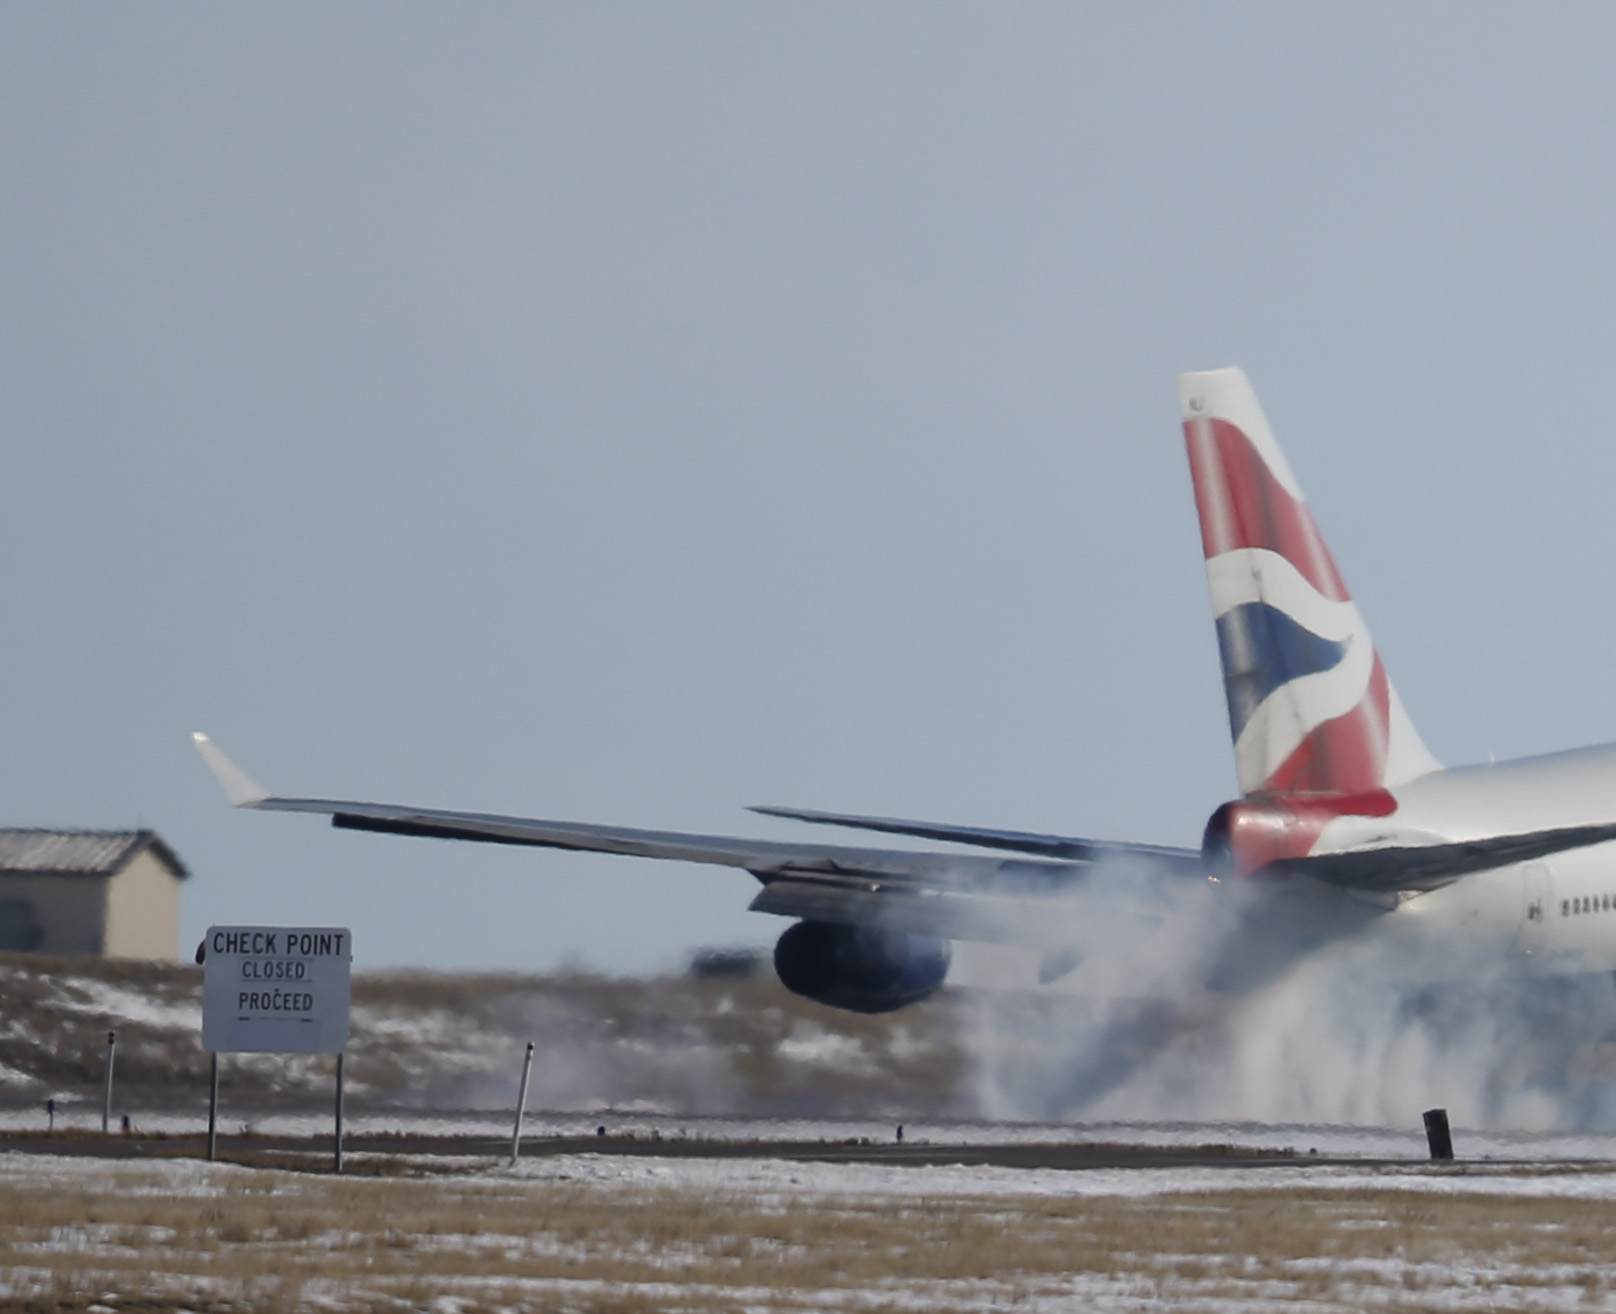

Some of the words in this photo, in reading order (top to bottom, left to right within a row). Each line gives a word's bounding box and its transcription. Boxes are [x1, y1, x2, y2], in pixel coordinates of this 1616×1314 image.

[213, 932, 277, 954] CHECK
[287, 934, 344, 956] POINT
[242, 961, 305, 978] CLOSED
[238, 992, 313, 1011] PROCEED
